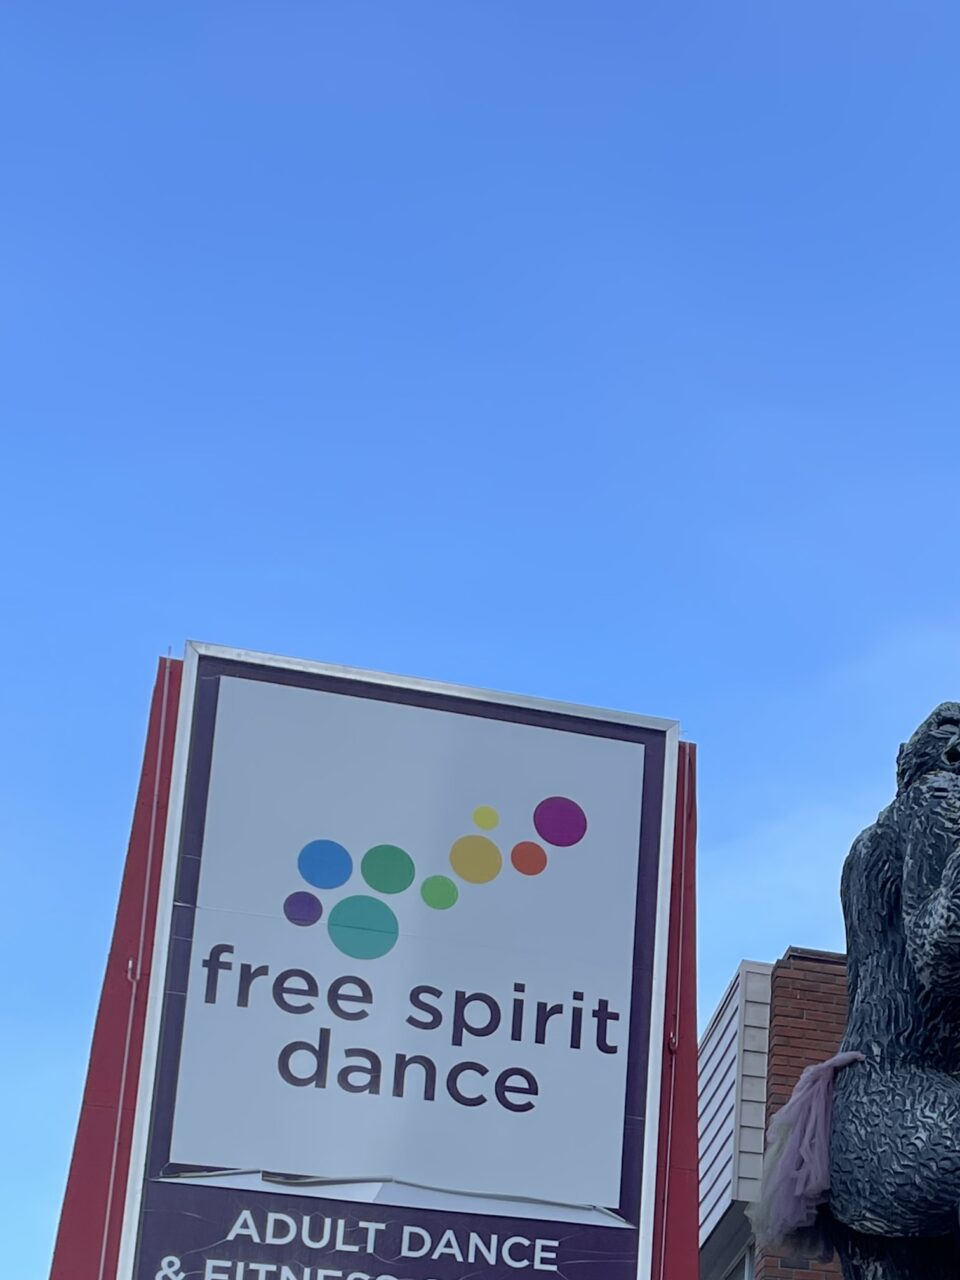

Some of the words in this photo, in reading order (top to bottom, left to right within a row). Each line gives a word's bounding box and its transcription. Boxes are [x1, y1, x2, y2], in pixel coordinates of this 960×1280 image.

[201, 943, 374, 1021] free
[406, 980, 621, 1055] spirit
[277, 1028, 540, 1112] dance
[227, 1209, 386, 1254] ADULT
[402, 1226, 559, 1271] DANCE
